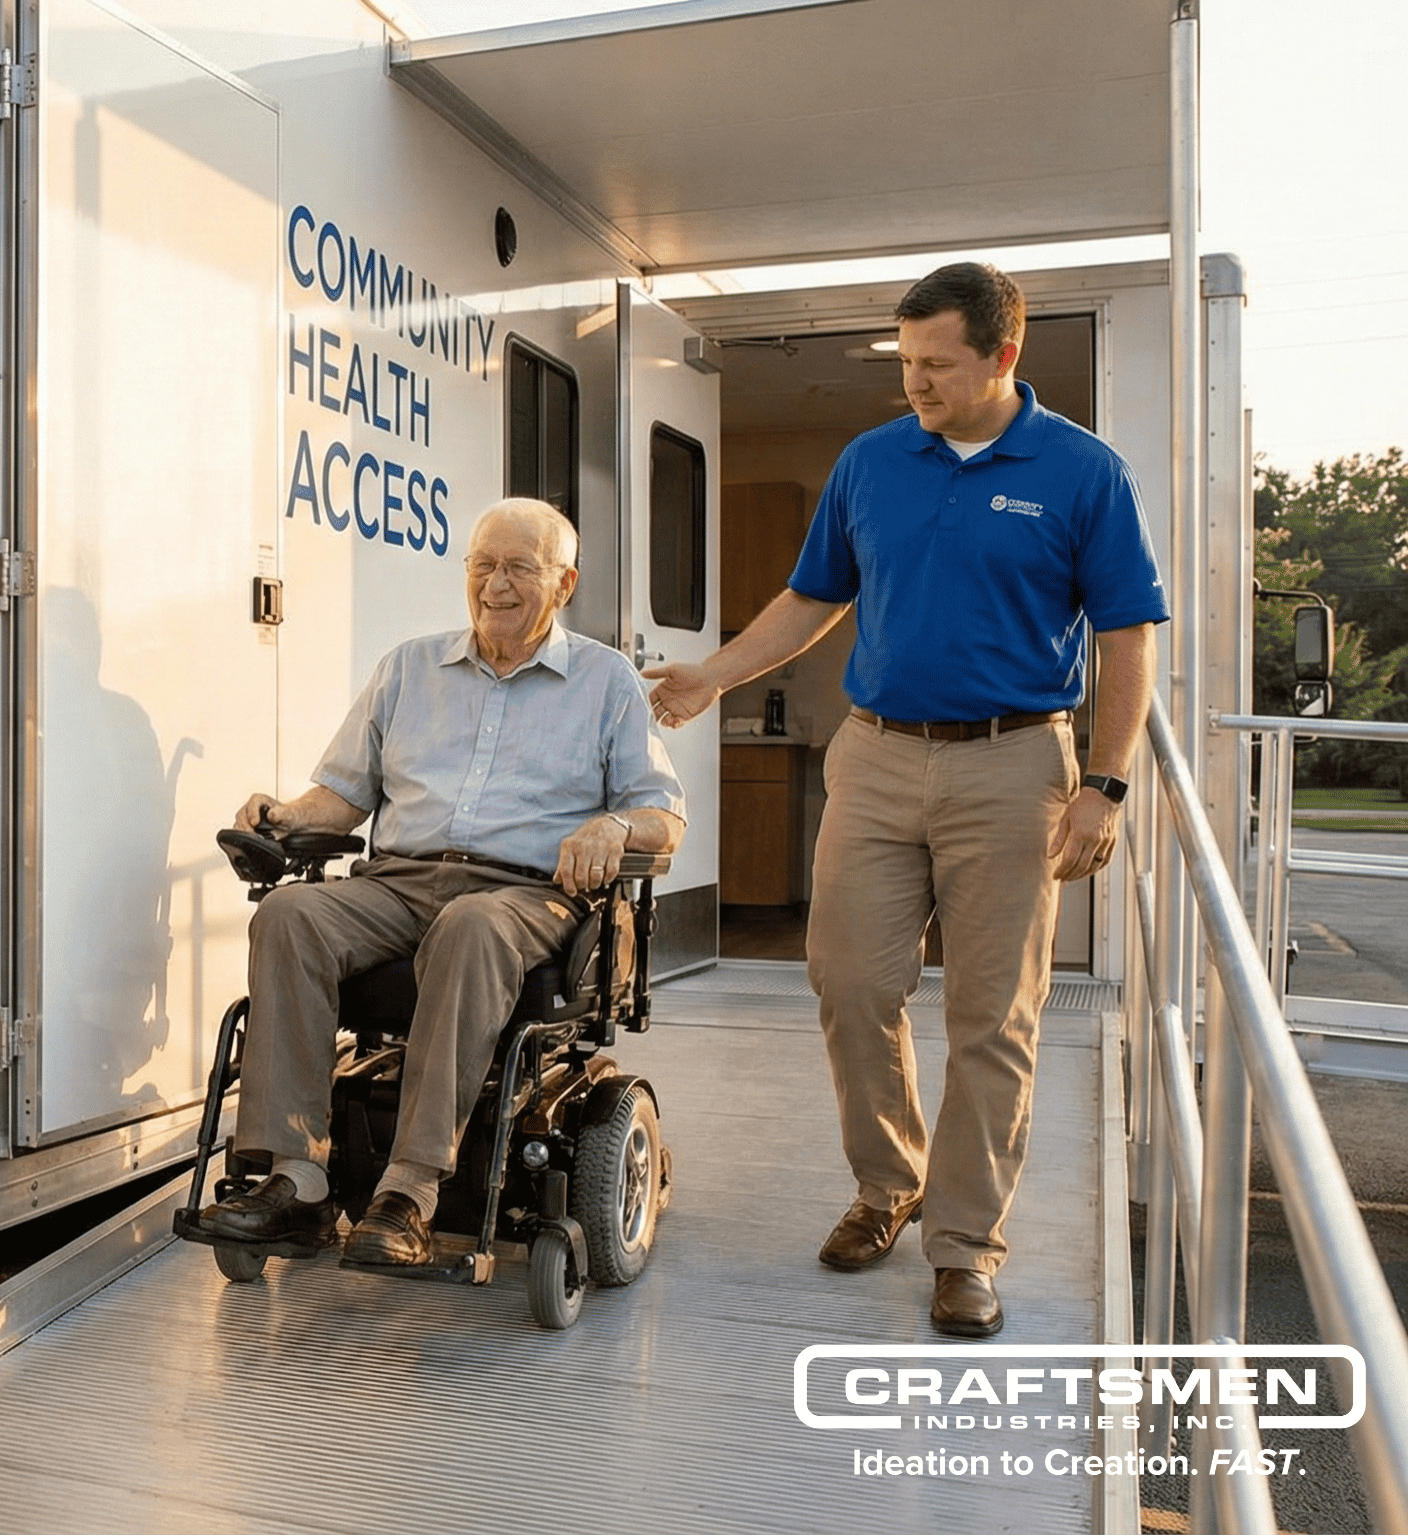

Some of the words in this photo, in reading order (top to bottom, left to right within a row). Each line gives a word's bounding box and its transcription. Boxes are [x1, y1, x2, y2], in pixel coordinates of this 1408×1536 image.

[288, 205, 495, 382] COMMUNITY
[289, 313, 430, 447] HEALTH
[285, 430, 449, 556] ACCESS
